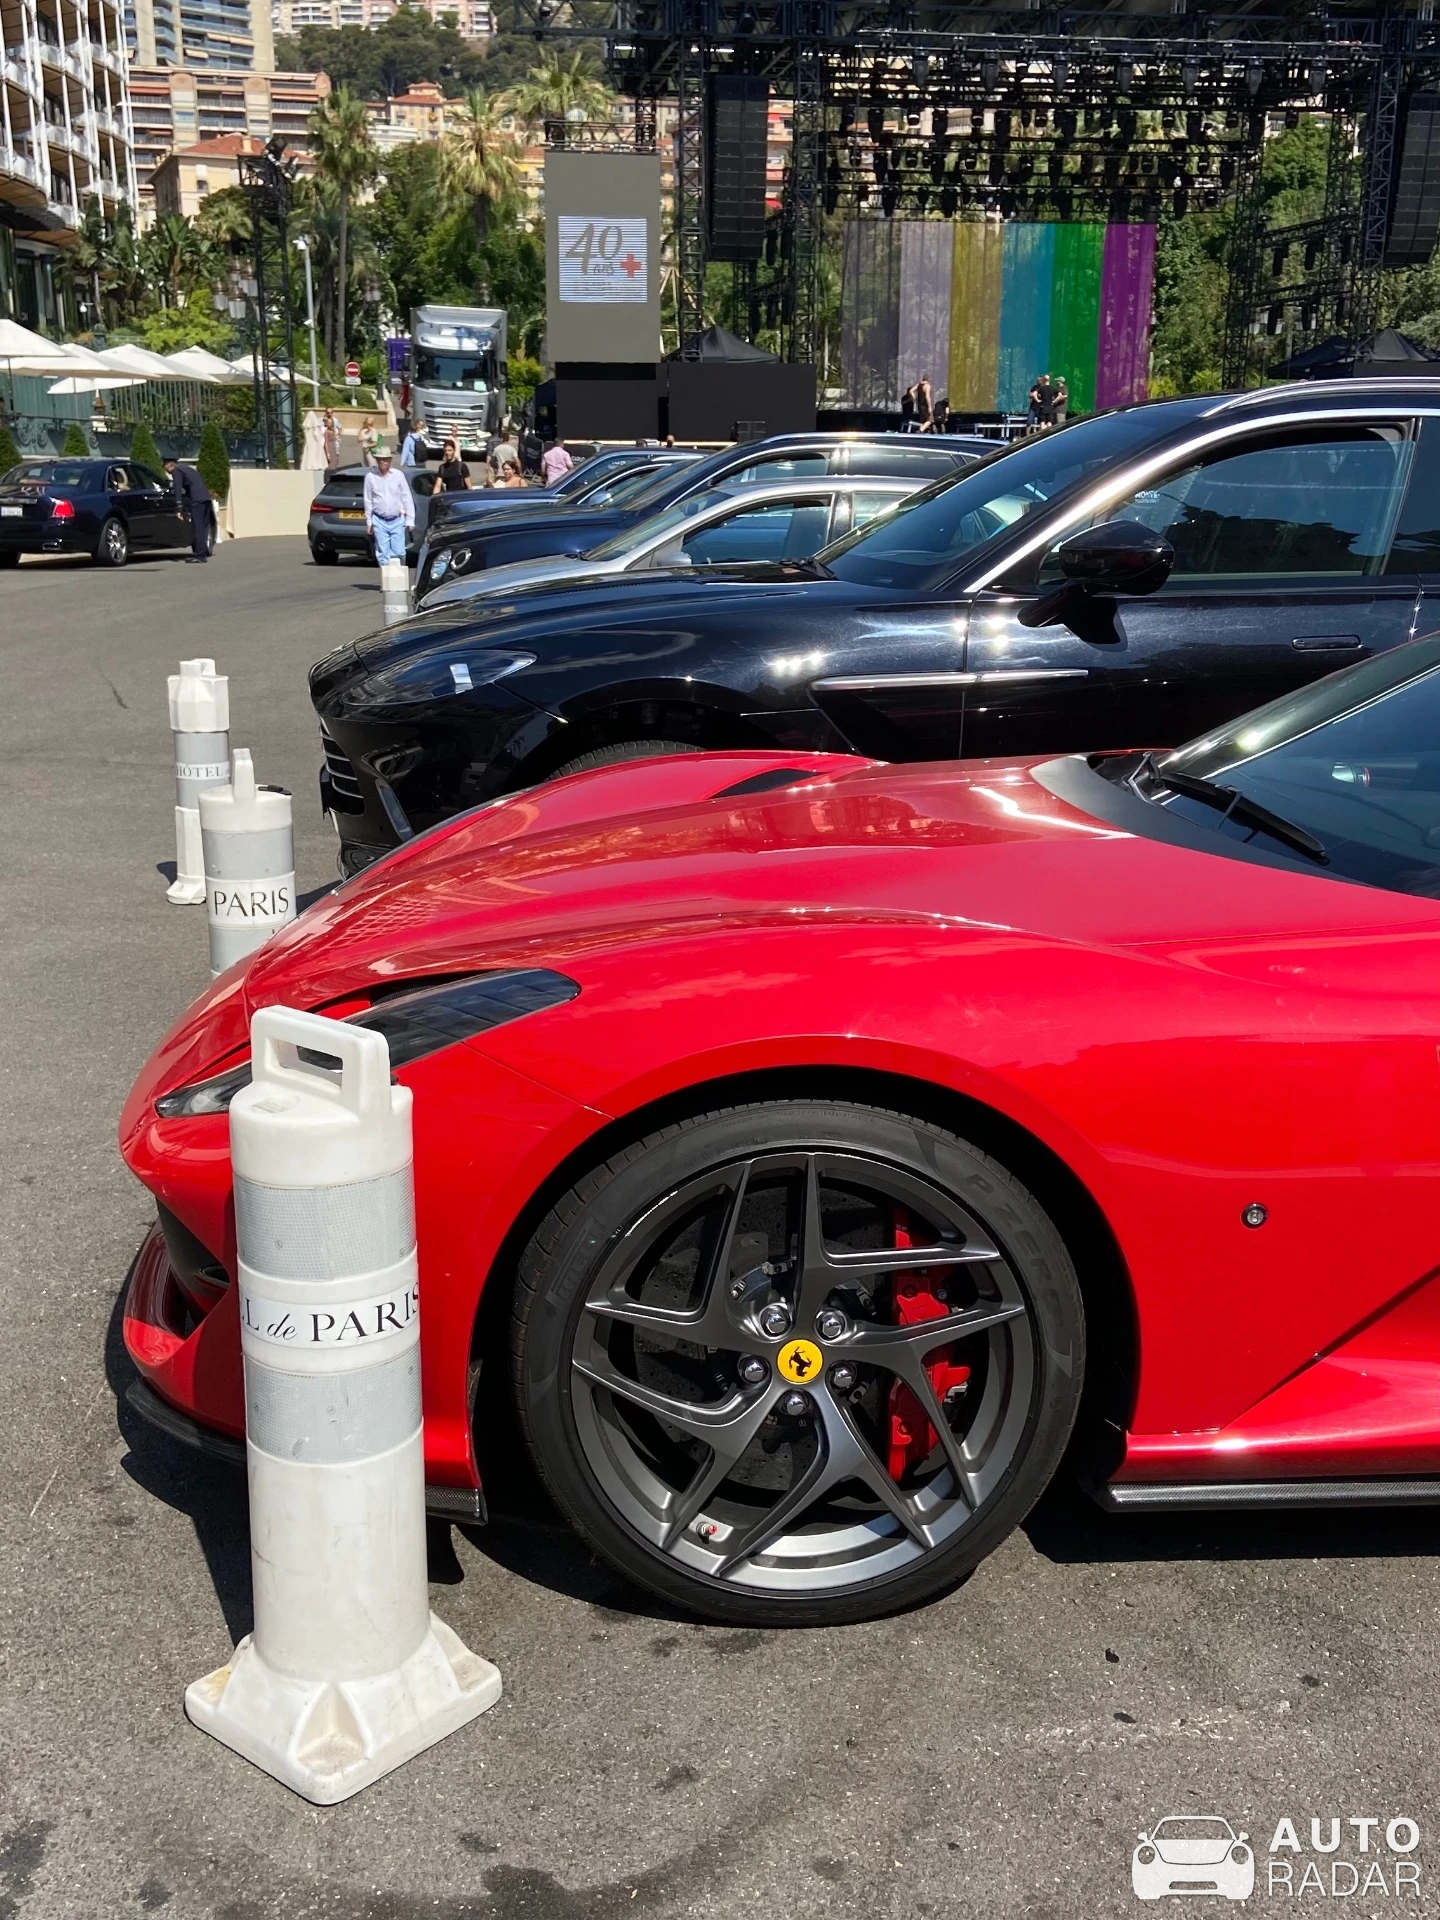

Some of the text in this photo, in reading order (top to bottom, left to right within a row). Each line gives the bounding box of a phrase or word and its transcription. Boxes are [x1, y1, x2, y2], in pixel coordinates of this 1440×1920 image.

[565, 223, 622, 276] 40
[214, 888, 289, 917] PARIS
[267, 1314, 298, 1340] de
